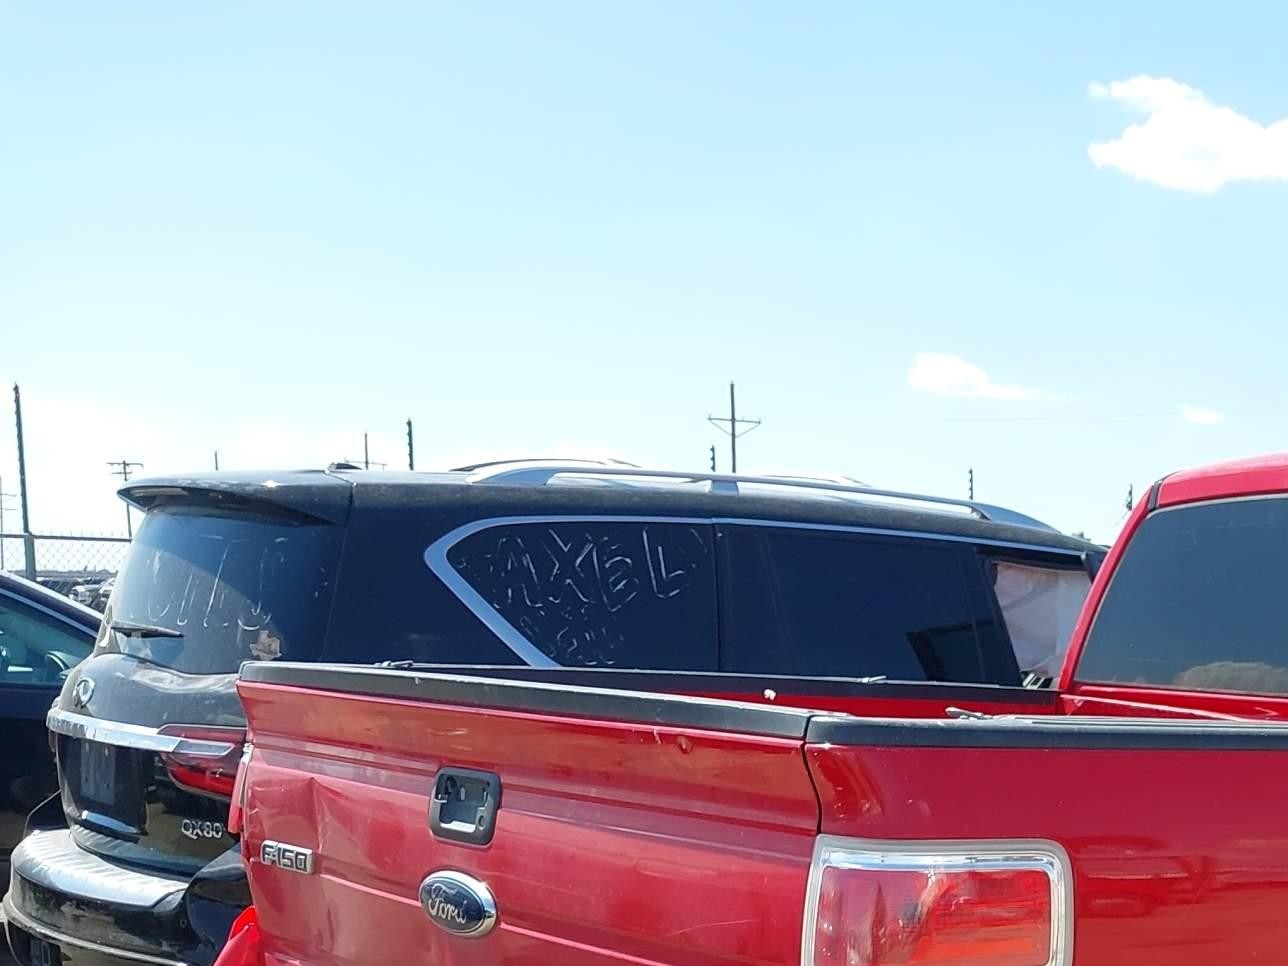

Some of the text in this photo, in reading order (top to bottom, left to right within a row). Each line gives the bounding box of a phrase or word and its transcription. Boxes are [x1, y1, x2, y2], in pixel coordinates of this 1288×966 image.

[181, 819, 223, 839] QX80
[262, 840, 313, 875] F-150
[425, 881, 467, 924] Ford
